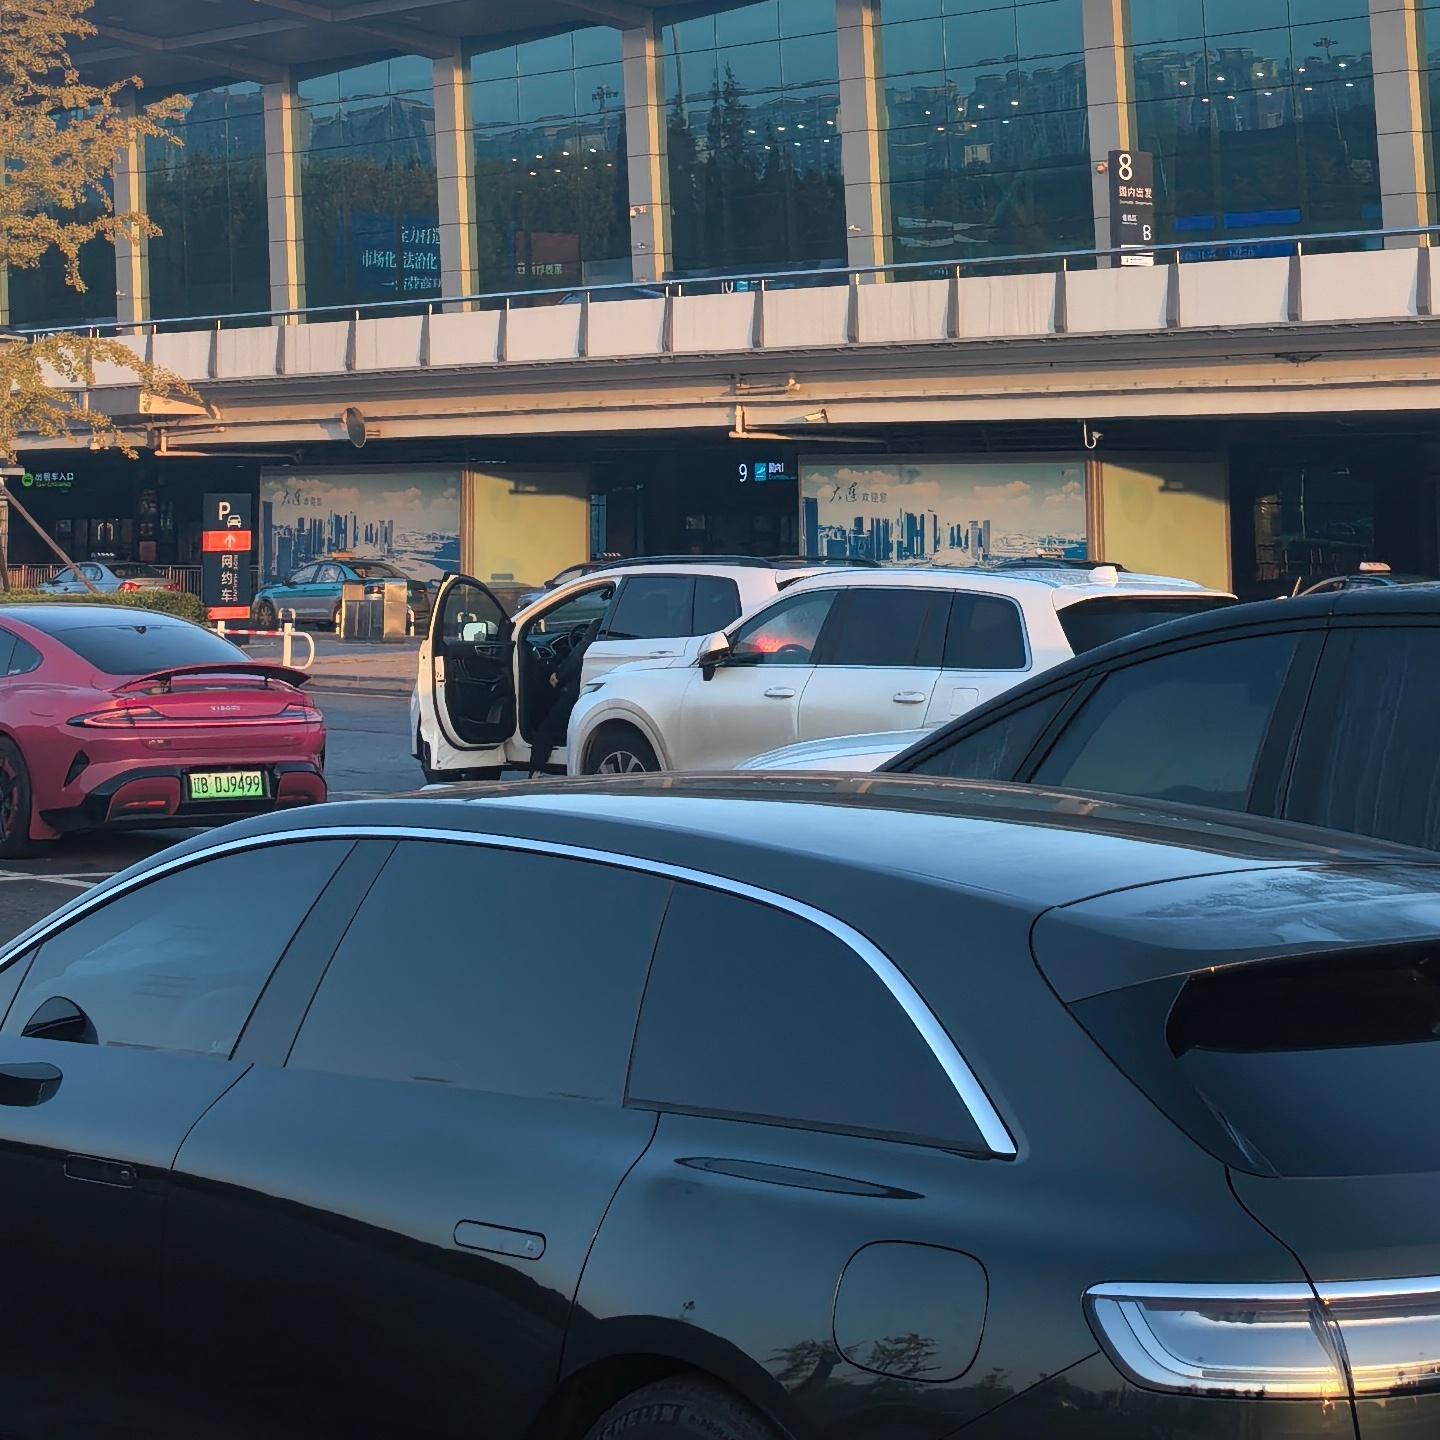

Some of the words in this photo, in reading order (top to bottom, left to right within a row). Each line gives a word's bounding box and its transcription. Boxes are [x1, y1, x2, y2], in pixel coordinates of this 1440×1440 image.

[1119, 153, 1133, 181] 8
[1143, 225, 1151, 240] B
[362, 249, 397, 268] 市场化
[403, 251, 438, 270] 法治化
[738, 463, 748, 482] 9
[218, 501, 231, 521] P
[221, 554, 233, 602] 网约车
